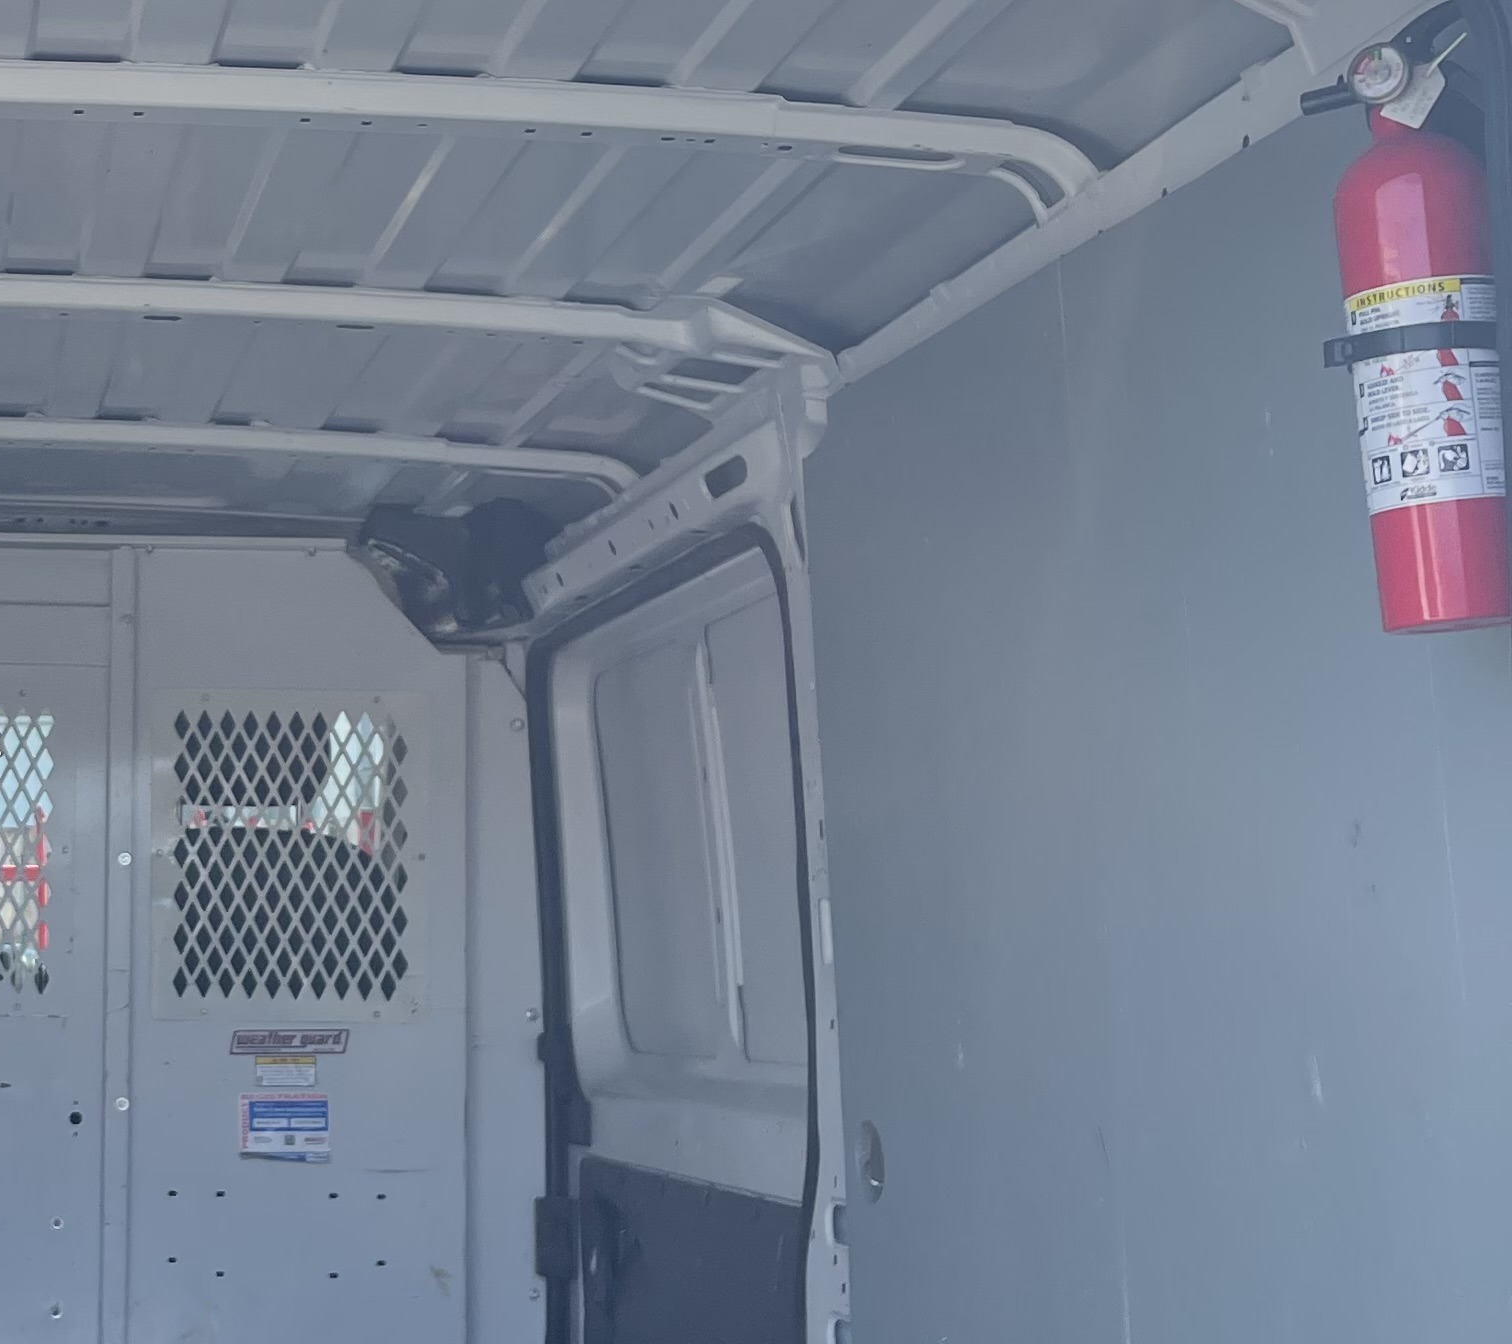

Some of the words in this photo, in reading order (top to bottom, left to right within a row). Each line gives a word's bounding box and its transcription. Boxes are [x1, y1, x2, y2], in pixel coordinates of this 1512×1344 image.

[1356, 280, 1446, 307] INSTRUCTIONS
[236, 1030, 297, 1045] weather
[300, 1030, 342, 1046] guard
